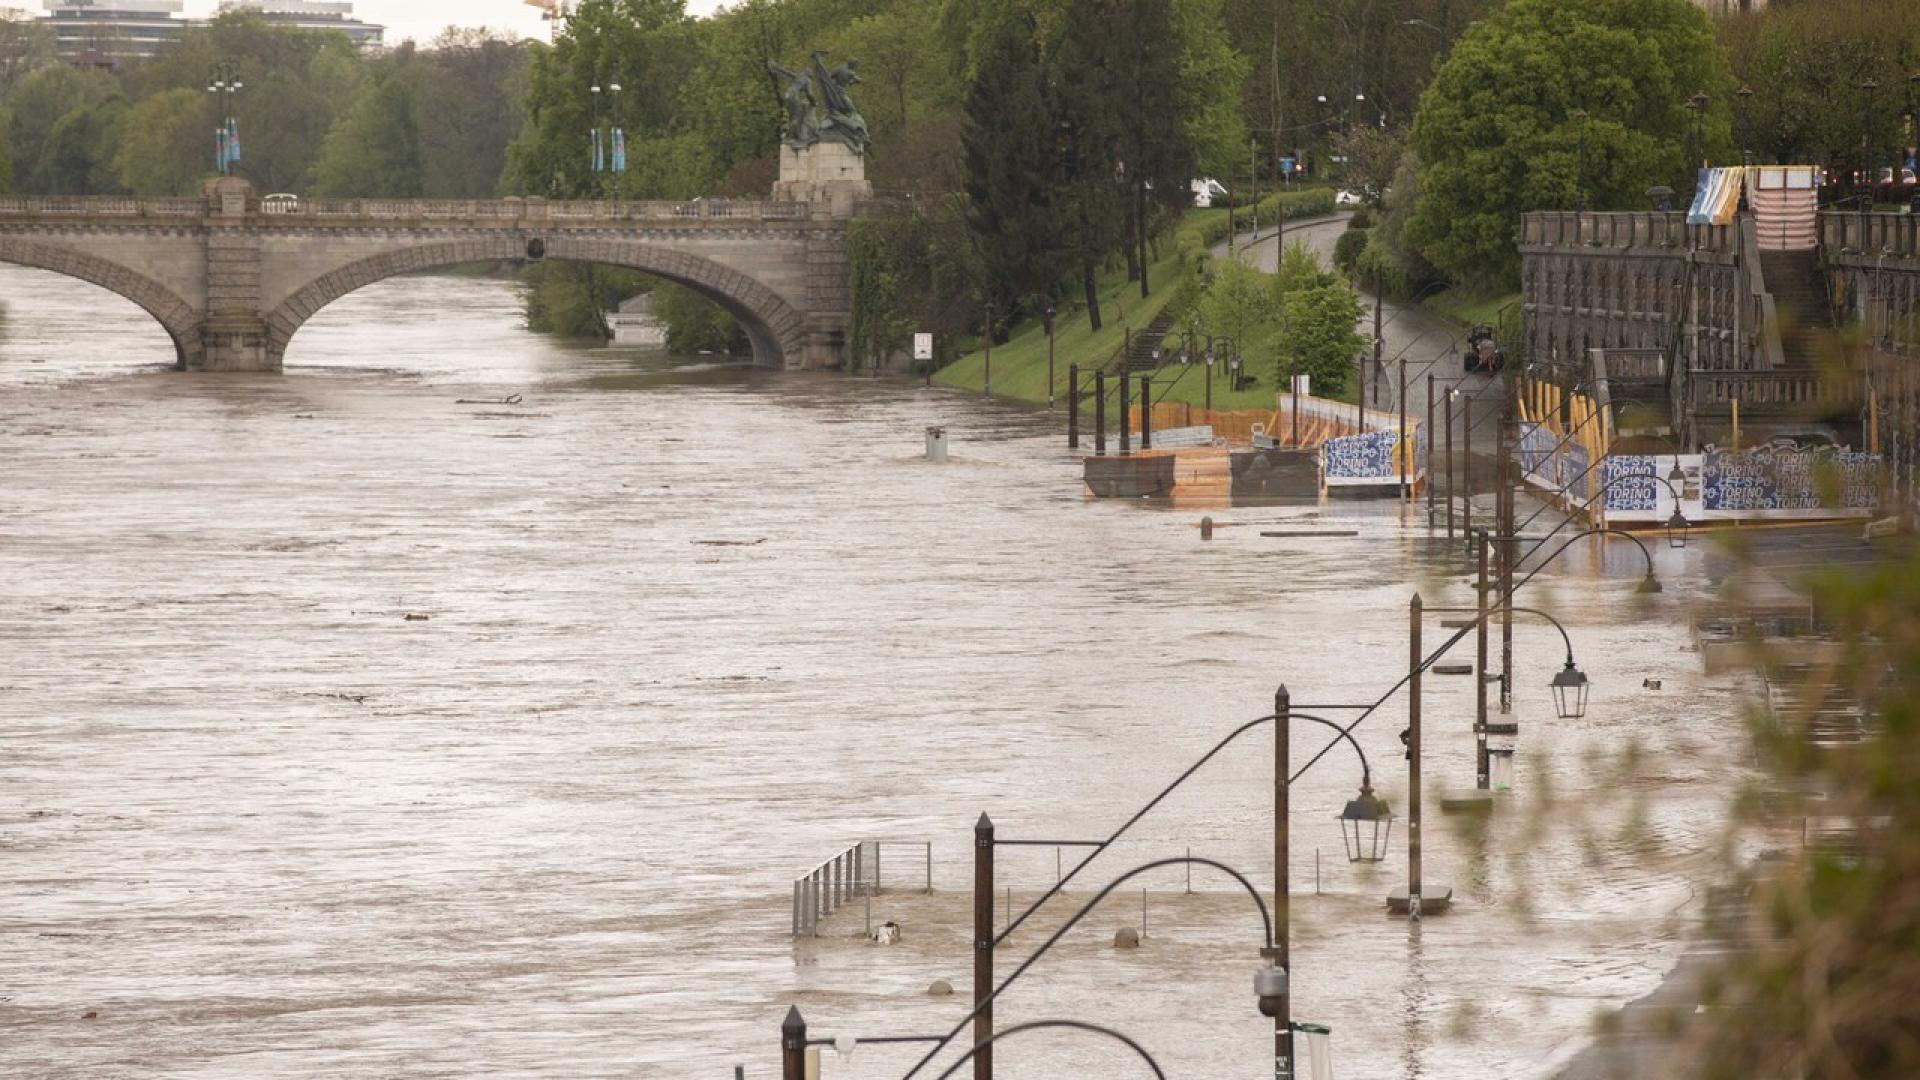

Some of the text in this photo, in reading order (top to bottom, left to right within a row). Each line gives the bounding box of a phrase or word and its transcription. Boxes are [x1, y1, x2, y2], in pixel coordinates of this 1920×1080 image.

[1331, 457, 1369, 468] TORINO
[1607, 465, 1651, 477] TORINO
[1719, 465, 1764, 476] TORINO
[1607, 488, 1651, 499] TORINO
[1719, 487, 1764, 498] TORINO
[1775, 497, 1820, 509] TORINO
